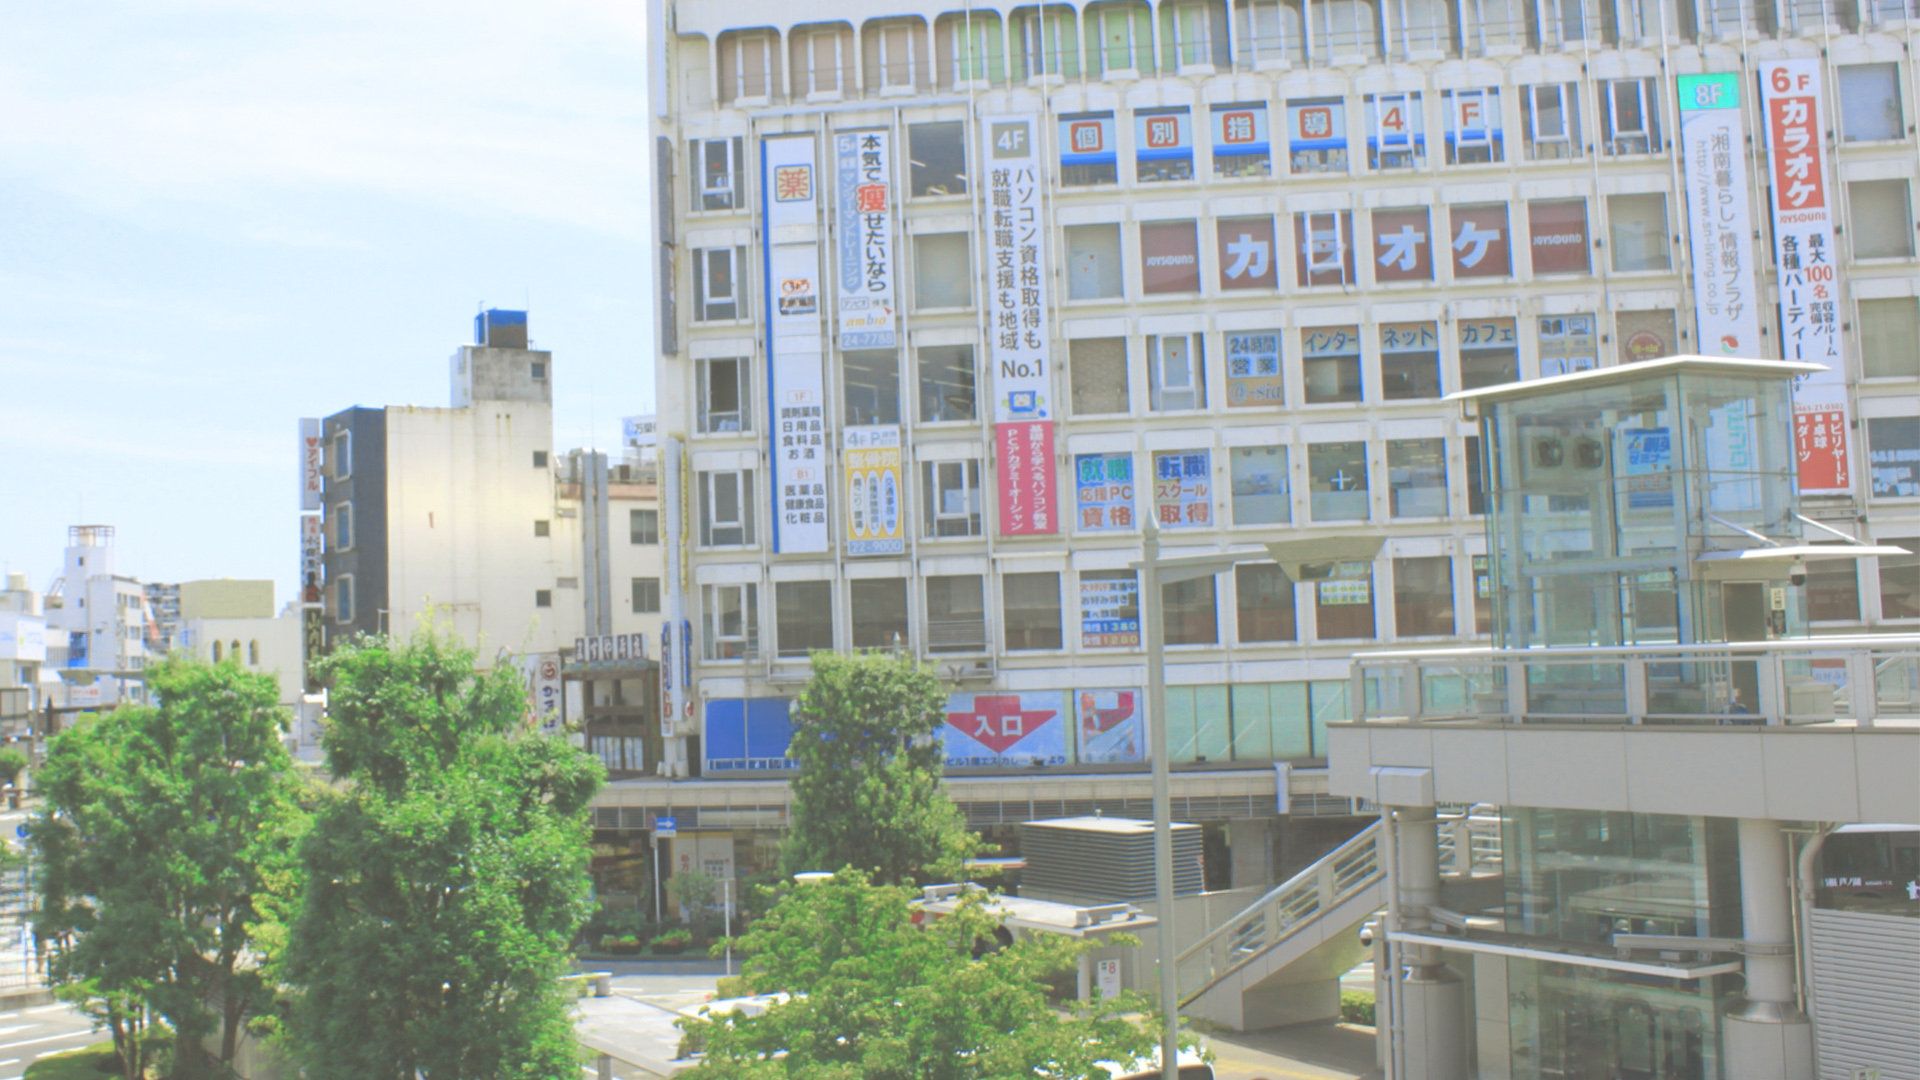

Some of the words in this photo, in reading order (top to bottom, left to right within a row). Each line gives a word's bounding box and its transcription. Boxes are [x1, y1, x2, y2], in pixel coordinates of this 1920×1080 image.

[1695, 83, 1723, 106] 8F
[997, 130, 1025, 151] 4F
[1781, 99, 1816, 207] カラオケ
[778, 168, 808, 199] 薬
[857, 134, 887, 292] 本気で痩せたいなら
[1780, 212, 1827, 223] JOYSOUND
[1533, 234, 1582, 246] JOYSOUND
[991, 168, 1019, 351] 就職転職支援も地域
[1017, 164, 1042, 350] パソコン資格取得も
[1146, 254, 1195, 267] JOYSOUND
[845, 314, 887, 328] ambio
[1229, 336, 1277, 354] 24時間
[1001, 359, 1043, 378] No.1
[1231, 355, 1277, 375] 営業
[781, 406, 821, 419] 調剤薬局
[782, 420, 821, 432] 日用品
[783, 434, 821, 447] 食料品
[847, 431, 867, 447] 4F
[1797, 424, 1811, 462] ダーツ
[1813, 424, 1828, 449] 卓球
[788, 448, 815, 460] お酒
[1831, 422, 1846, 486] ビリヤード
[1080, 458, 1129, 482] 就職
[1157, 455, 1207, 479] 転職
[784, 484, 825, 497] 医薬品
[1156, 483, 1208, 499] スクール
[785, 498, 825, 511] 健康食品
[786, 512, 825, 525] 化粧品
[1082, 505, 1132, 528] 資格
[1159, 502, 1209, 524] 取得
[974, 715, 1022, 737] 入口
[1108, 961, 1116, 974] 8
